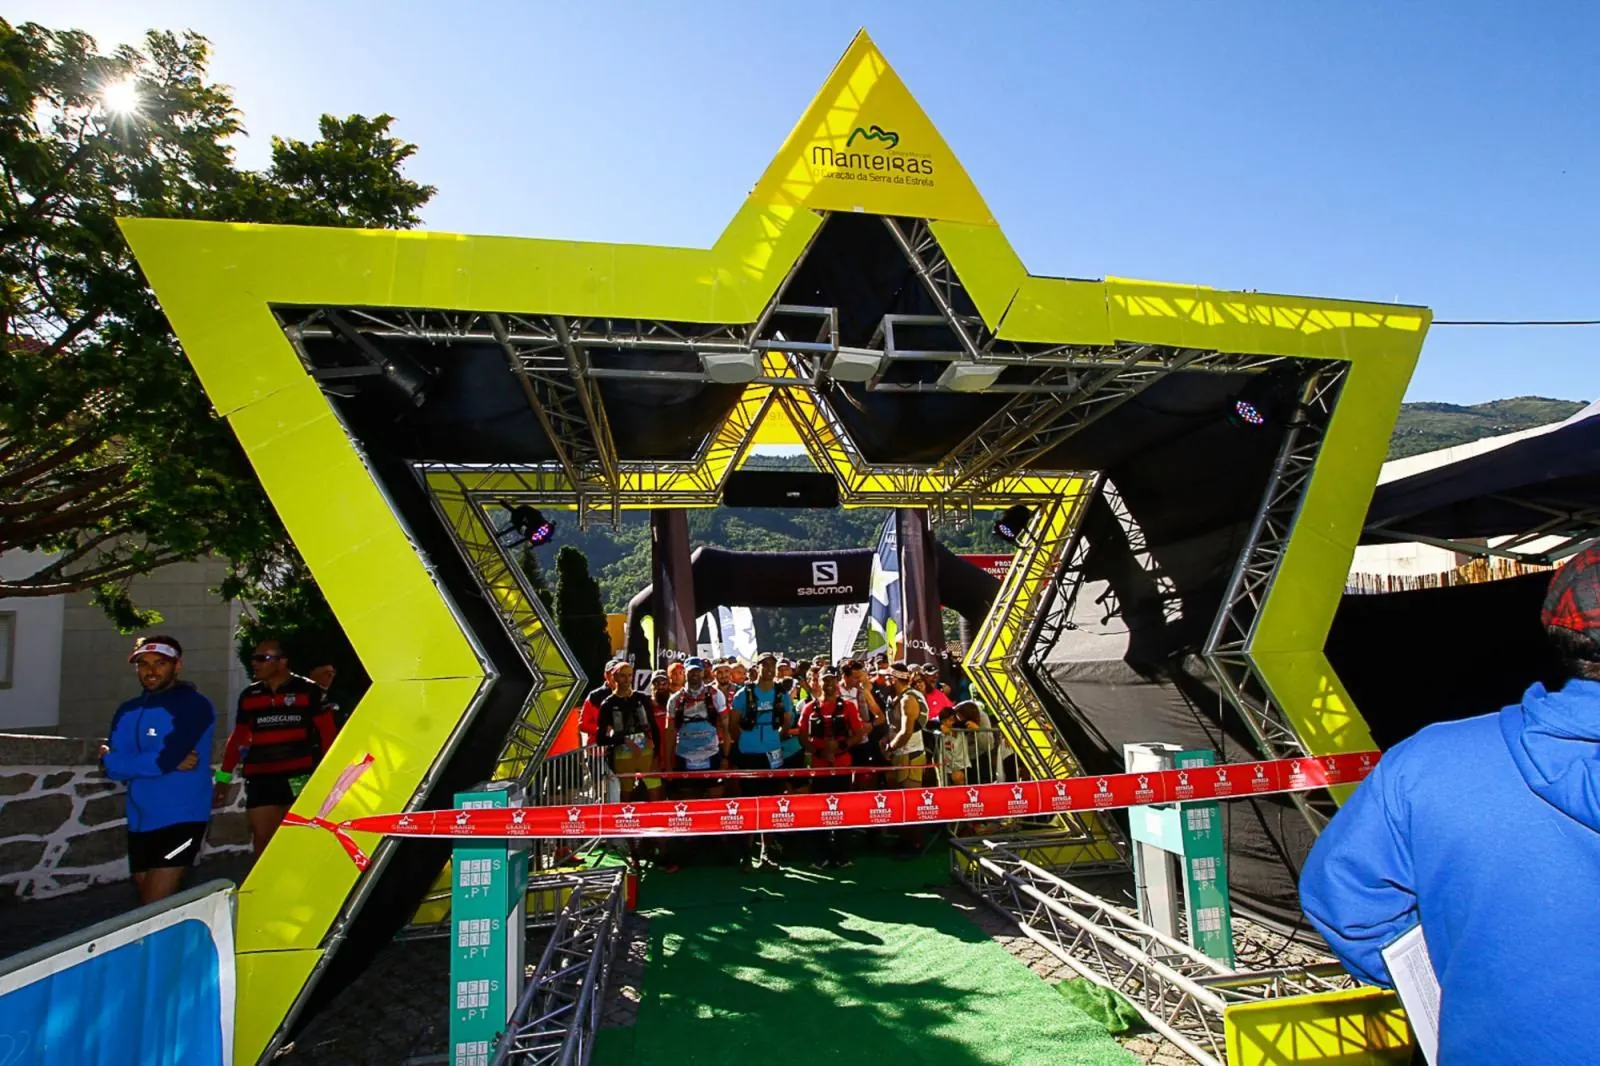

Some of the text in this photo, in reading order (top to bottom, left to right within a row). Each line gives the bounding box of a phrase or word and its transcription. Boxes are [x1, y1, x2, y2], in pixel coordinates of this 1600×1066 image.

[857, 173, 867, 181] da
[870, 172, 892, 183] Serra
[893, 176, 904, 185] da
[906, 175, 934, 187] Estrela
